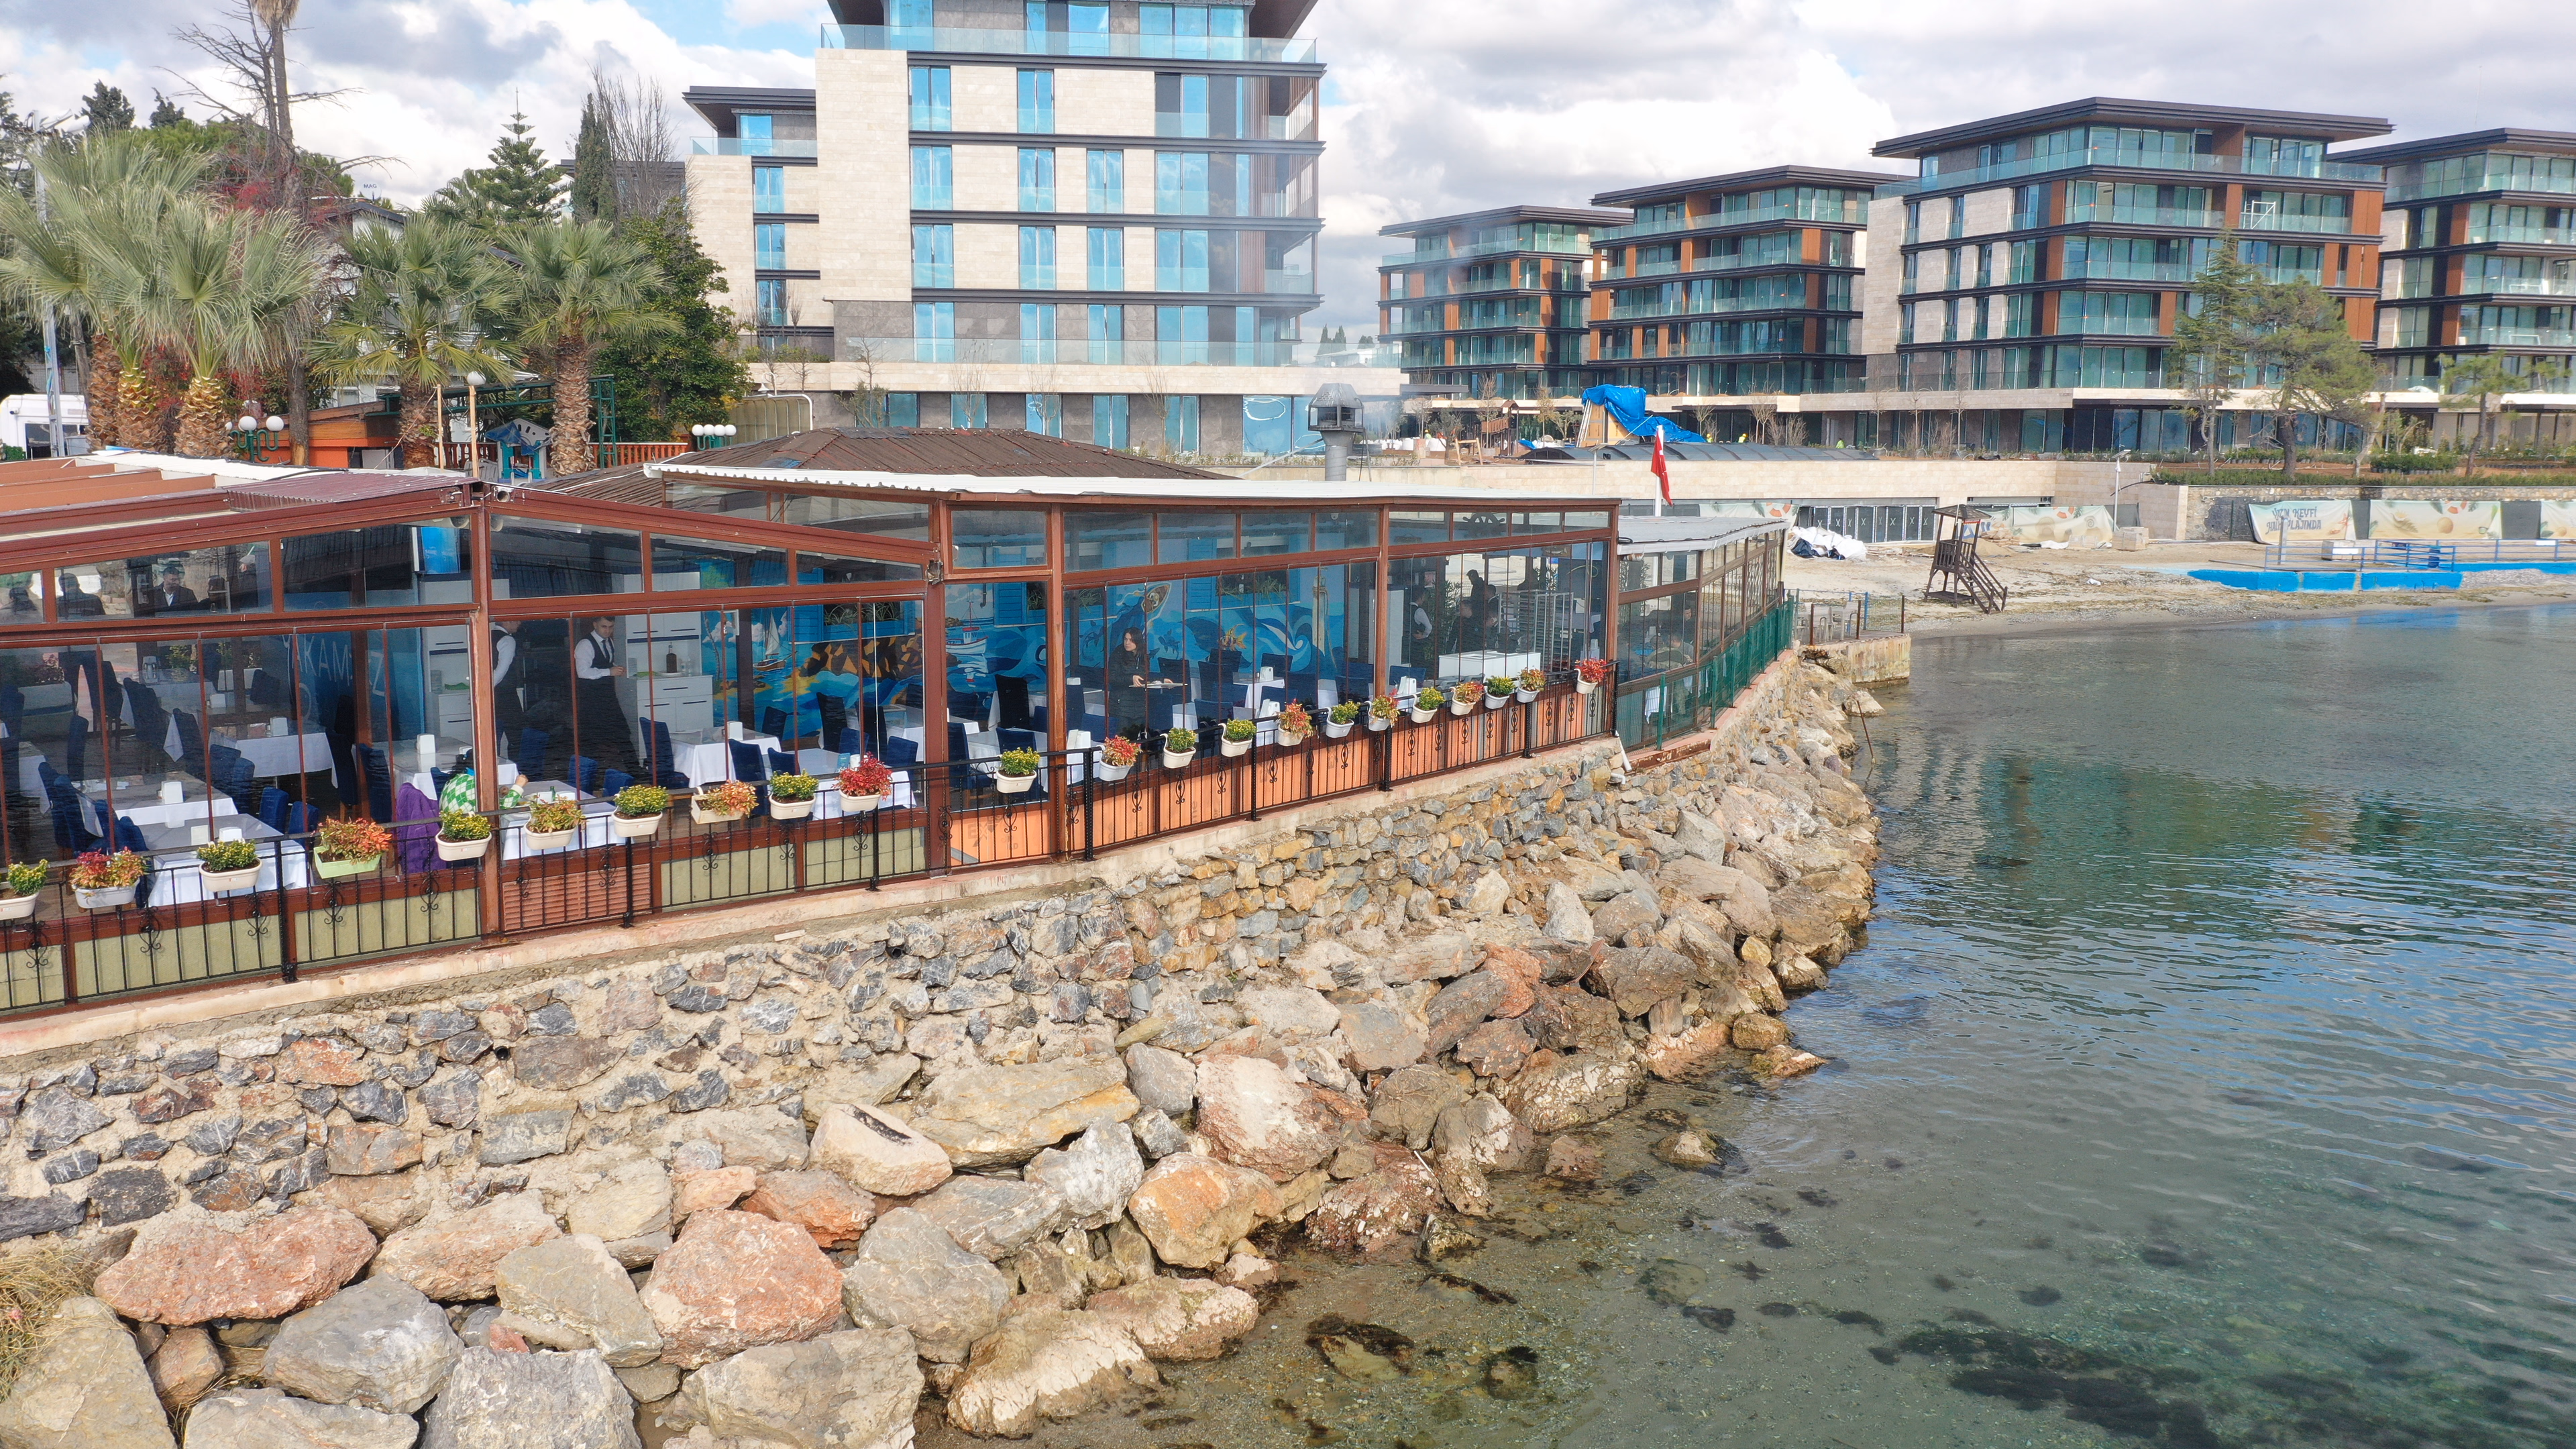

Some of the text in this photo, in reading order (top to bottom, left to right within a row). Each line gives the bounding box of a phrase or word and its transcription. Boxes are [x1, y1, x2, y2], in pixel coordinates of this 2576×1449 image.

[2292, 506, 2318, 520] KEYFİ
[2287, 519, 2322, 531] PLAJINDA
[282, 634, 385, 699] YAKAMZ
